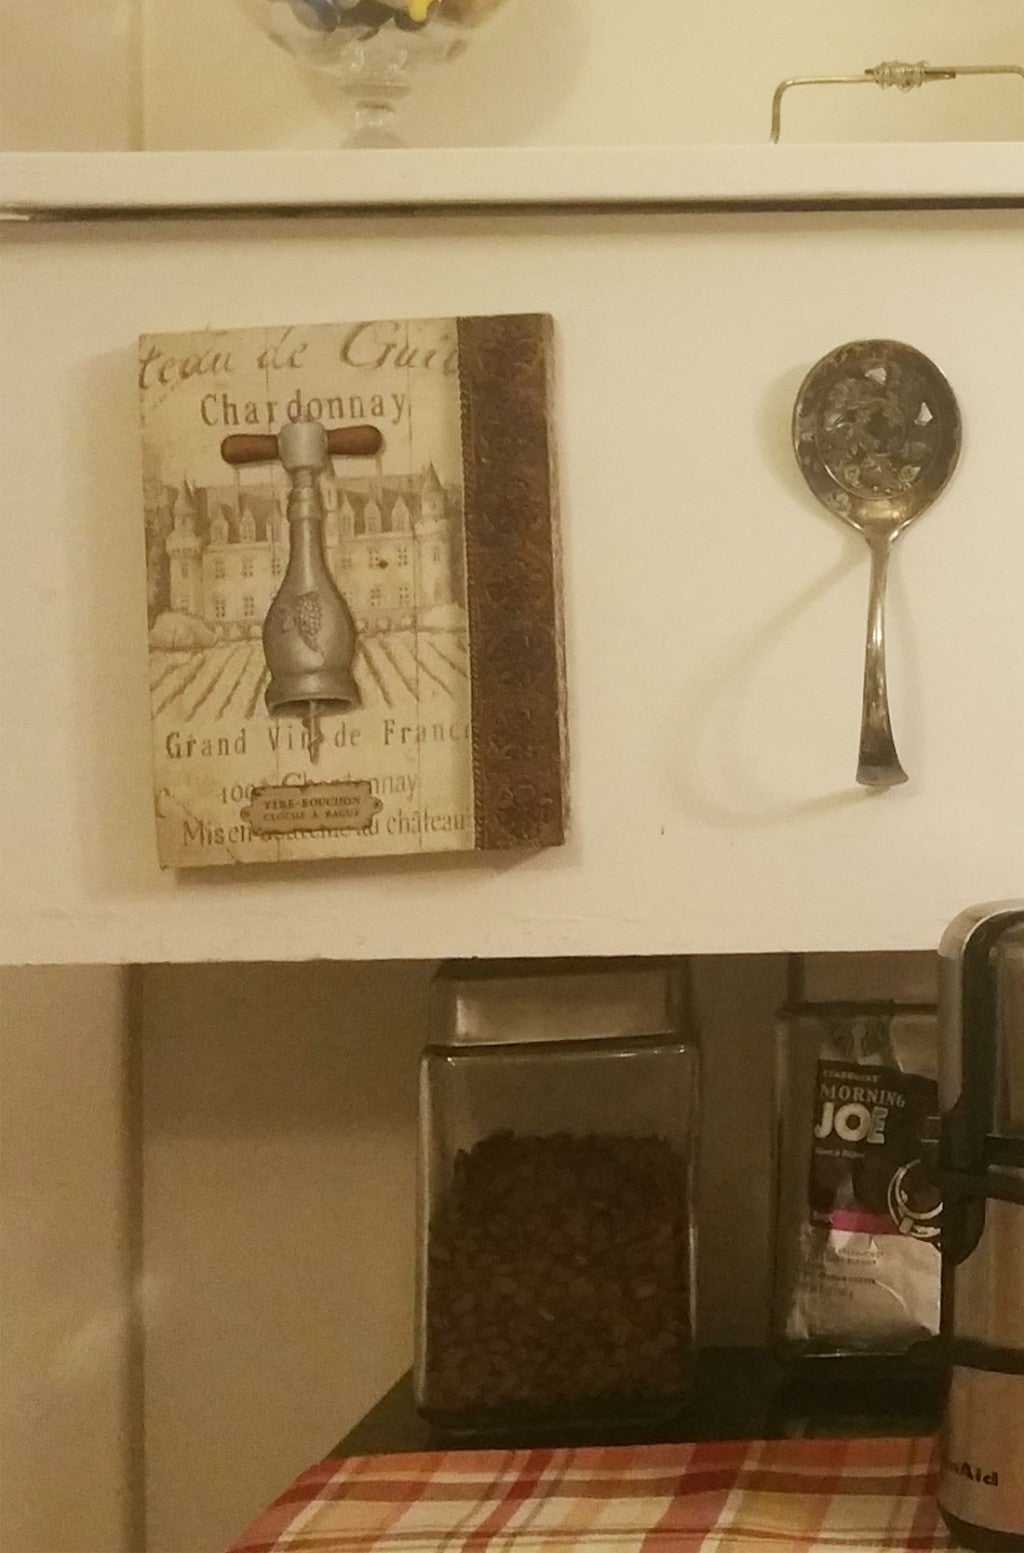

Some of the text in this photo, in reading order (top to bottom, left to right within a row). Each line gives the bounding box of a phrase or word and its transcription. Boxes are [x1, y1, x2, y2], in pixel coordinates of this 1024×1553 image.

[200, 388, 405, 427] Chardonnay
[165, 728, 248, 760] Grand
[267, 724, 312, 751] Vin
[334, 720, 361, 749] de
[820, 1083, 906, 1108] MORNING
[813, 1101, 889, 1145] JOE
